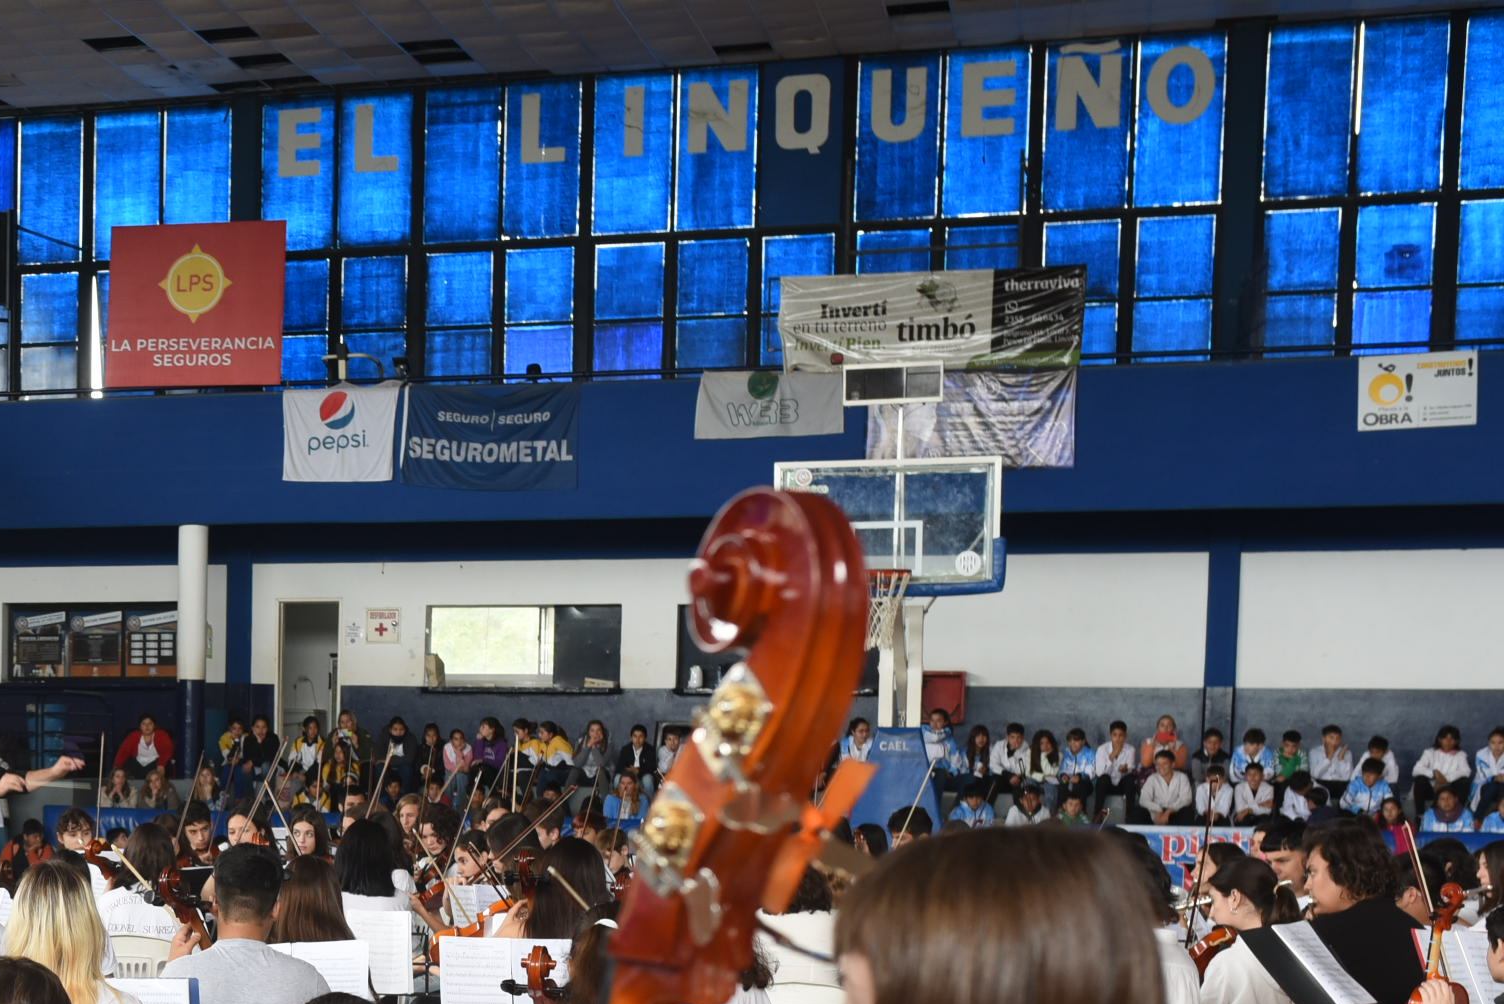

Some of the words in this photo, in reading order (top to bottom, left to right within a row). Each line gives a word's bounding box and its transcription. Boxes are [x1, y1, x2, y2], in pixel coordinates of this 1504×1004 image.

[176, 274, 214, 292] LPS
[820, 300, 887, 319] Invertí
[793, 323, 810, 334] en
[815, 322, 830, 333] tu
[833, 319, 887, 332] terreno
[897, 314, 976, 342] timbó
[111, 339, 131, 351] LA
[137, 337, 275, 351] PERSEVERANCIA
[153, 353, 232, 367] SEGUROS
[437, 410, 489, 424] SEGURO
[497, 411, 551, 425] SEGURO
[1363, 412, 1413, 426] OBRA
[307, 430, 367, 455] pepsi
[408, 436, 573, 463] SEGUROMETAL
[879, 740, 909, 751] CAEL
